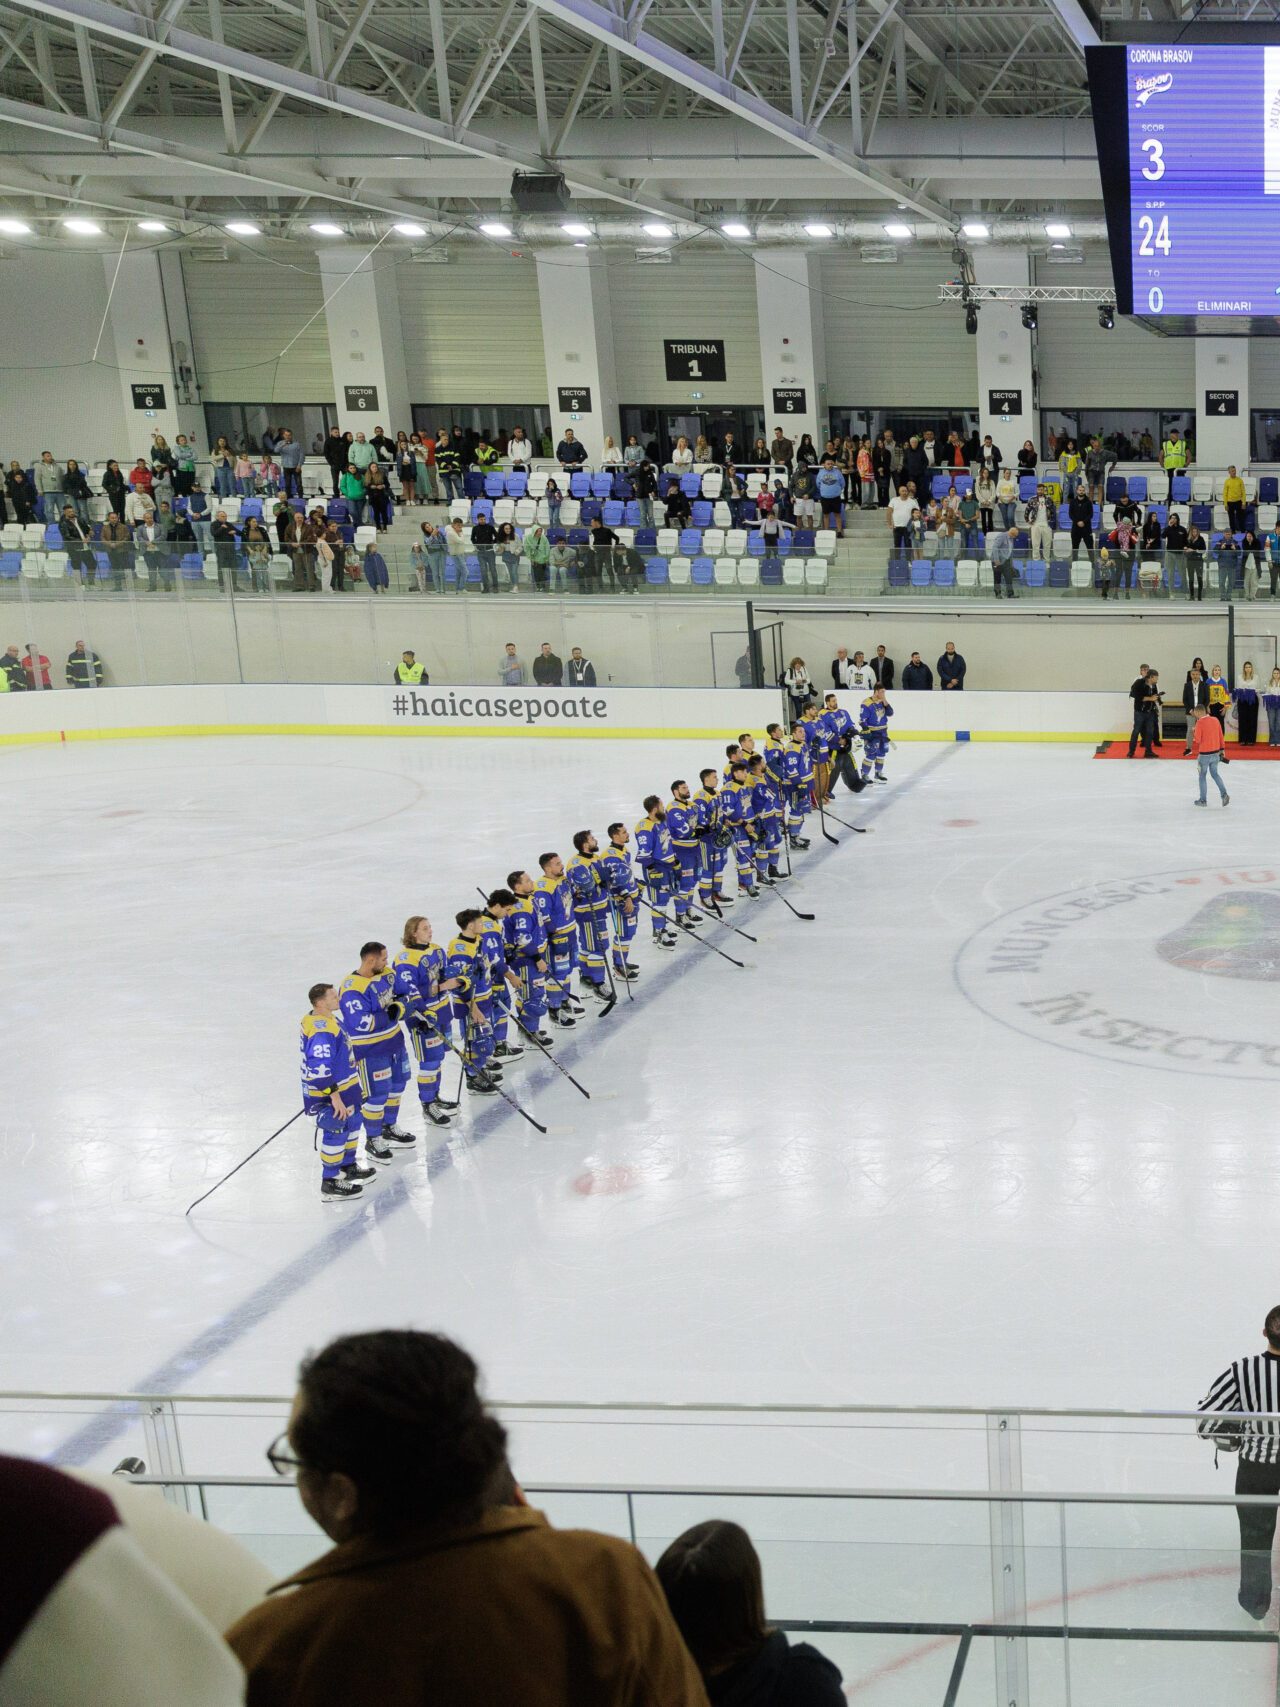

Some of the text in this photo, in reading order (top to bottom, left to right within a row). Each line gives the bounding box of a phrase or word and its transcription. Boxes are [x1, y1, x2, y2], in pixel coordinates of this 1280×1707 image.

[1130, 49, 1193, 63] CORONA BRASOV
[1142, 124, 1165, 132] SCOR
[1141, 139, 1165, 180] 3
[1138, 215, 1172, 256] 24
[1148, 286, 1164, 313] 0
[1197, 301, 1252, 311] ELIMINARI
[670, 344, 718, 354] TRIBUNA
[688, 359, 703, 377] 1
[145, 396, 154, 407] 6
[357, 398, 367, 409] 6
[571, 399, 579, 410] 5
[786, 400, 794, 411] 5
[1001, 402, 1010, 412] 4
[1218, 402, 1226, 413] 4
[392, 691, 608, 724] #haicasepoate
[788, 756, 798, 766] 26
[986, 881, 1172, 974] MUNCESC
[486, 937, 499, 949] 41
[345, 999, 363, 1015] 73
[313, 1043, 331, 1059] 25
